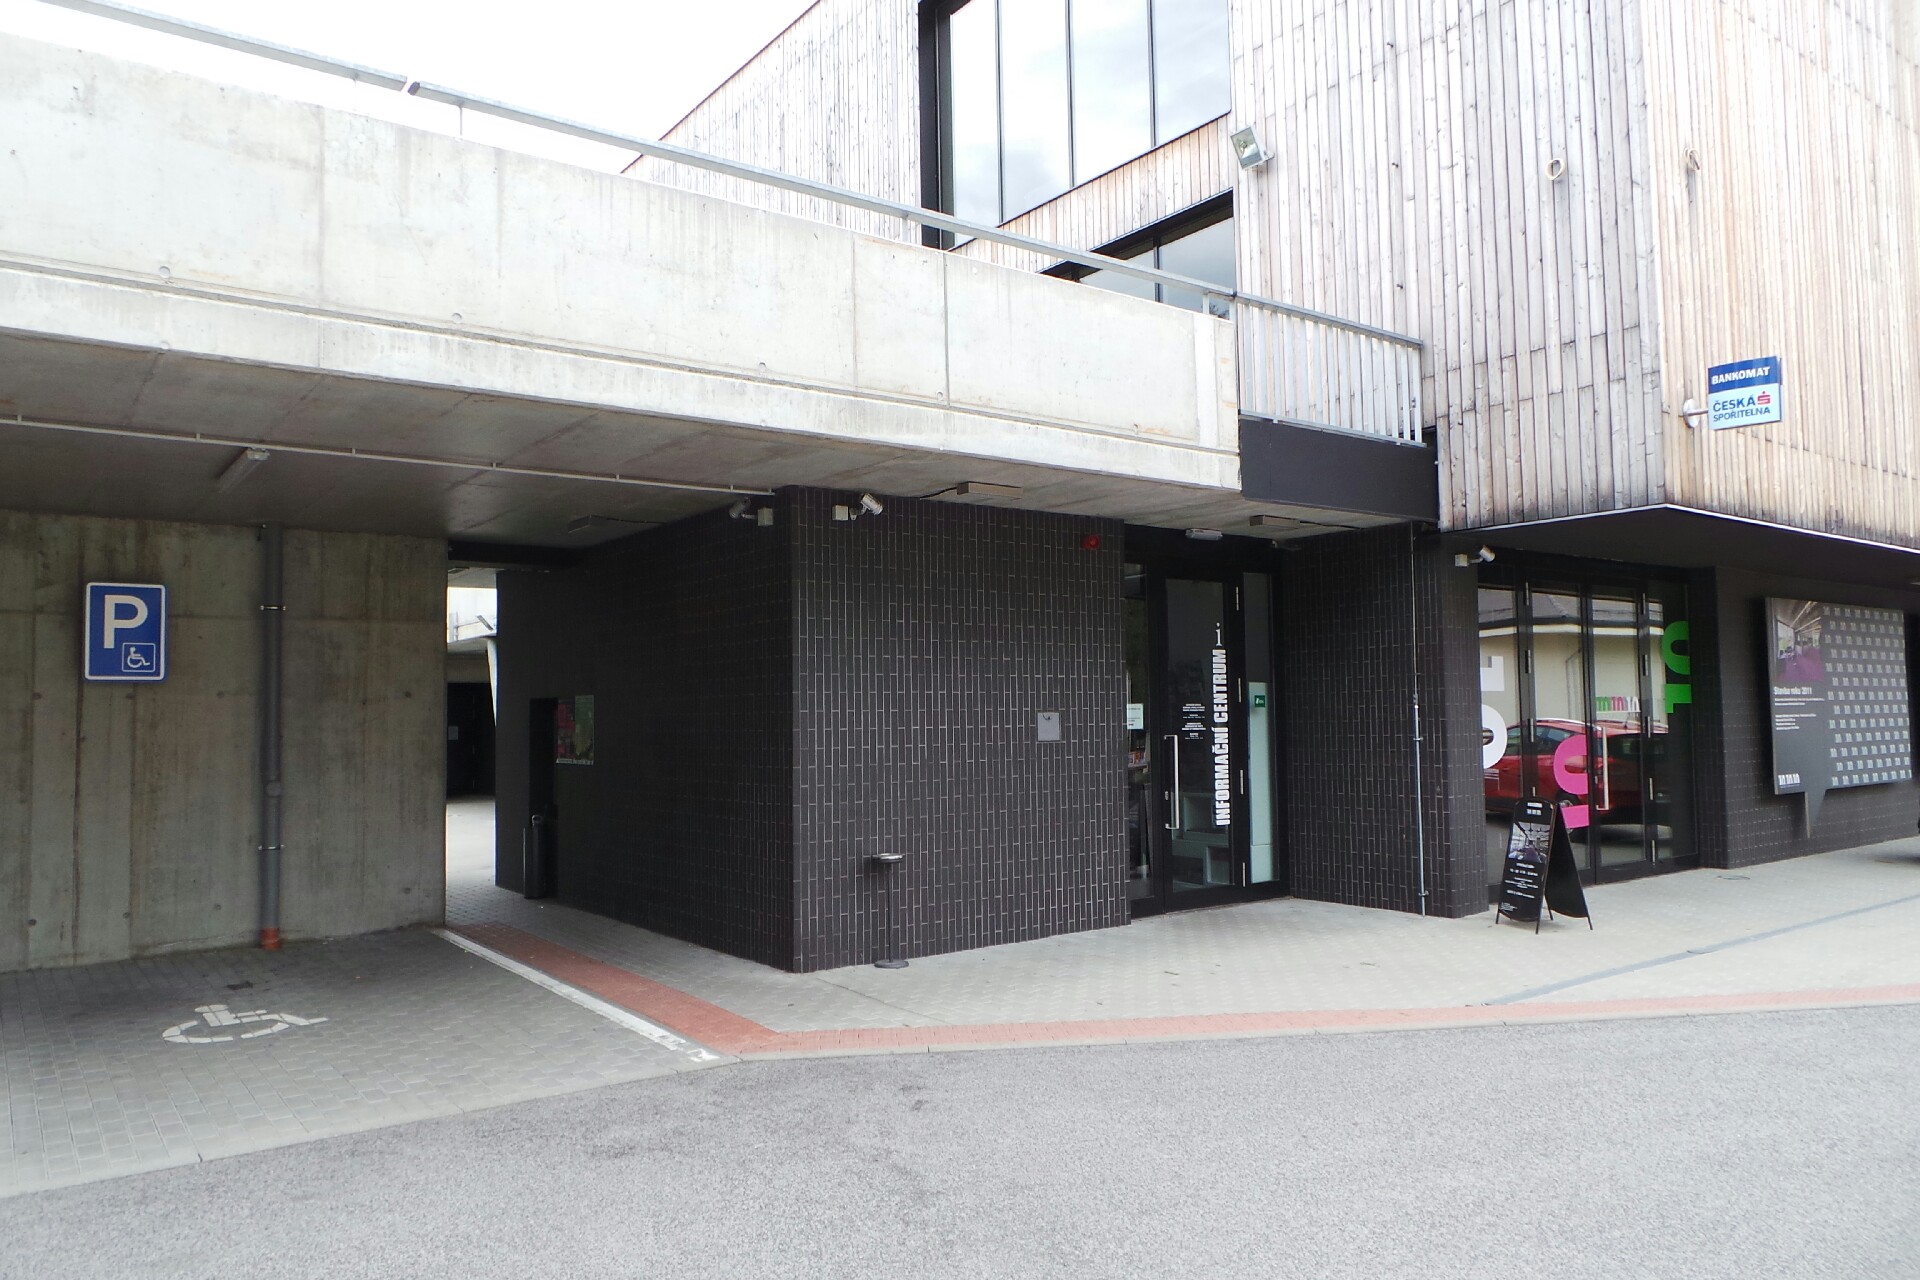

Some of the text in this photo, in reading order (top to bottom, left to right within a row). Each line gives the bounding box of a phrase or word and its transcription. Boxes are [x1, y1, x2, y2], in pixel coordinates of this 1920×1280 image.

[1711, 366, 1770, 385] BANKOMAT
[1713, 394, 1756, 412] ČESKÁ
[1713, 406, 1771, 422] SPOŘITELNA
[103, 594, 148, 649] P
[1216, 622, 1223, 647] i
[1211, 649, 1231, 826] INFORMAČNÍ CENTRUM
